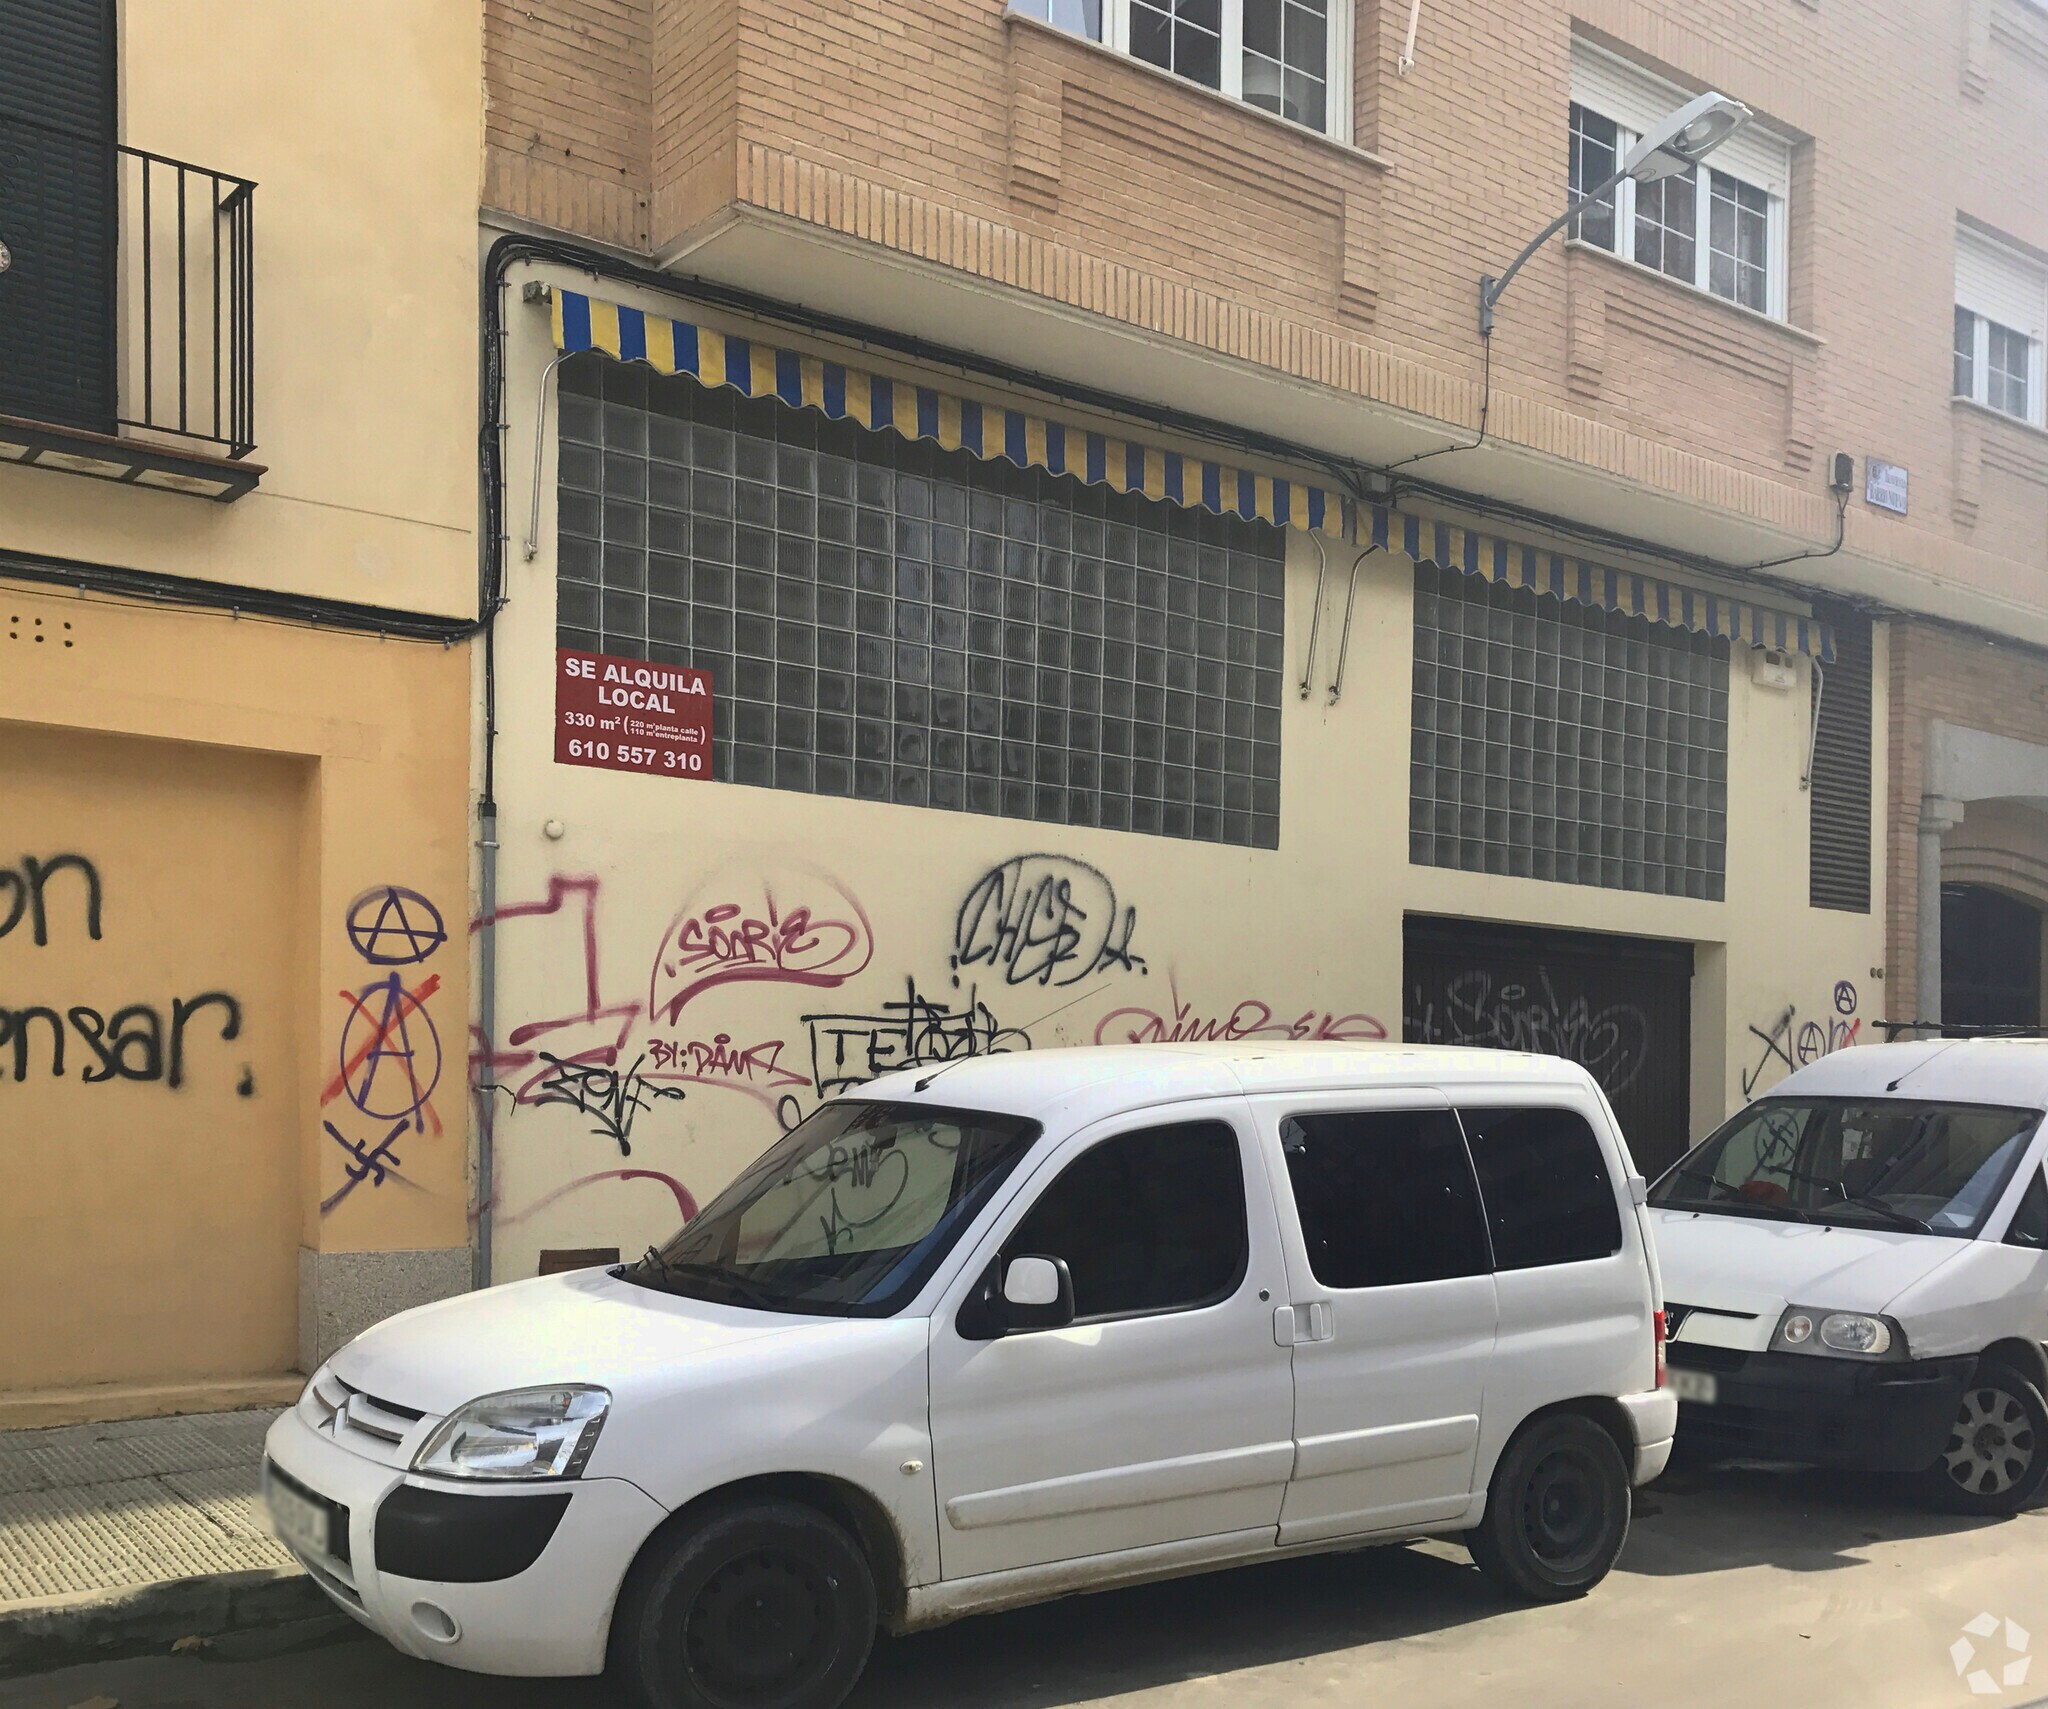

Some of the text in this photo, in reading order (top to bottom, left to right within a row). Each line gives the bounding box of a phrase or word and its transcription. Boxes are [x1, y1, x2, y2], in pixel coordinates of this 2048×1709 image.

[565, 658, 706, 696] SE ALQUILA
[598, 686, 676, 714] LOCAL
[564, 711, 595, 727] 330
[630, 720, 645, 729] 220
[680, 728, 699, 736] calle
[630, 728, 645, 736] 110
[568, 739, 702, 772] 610 557 310
